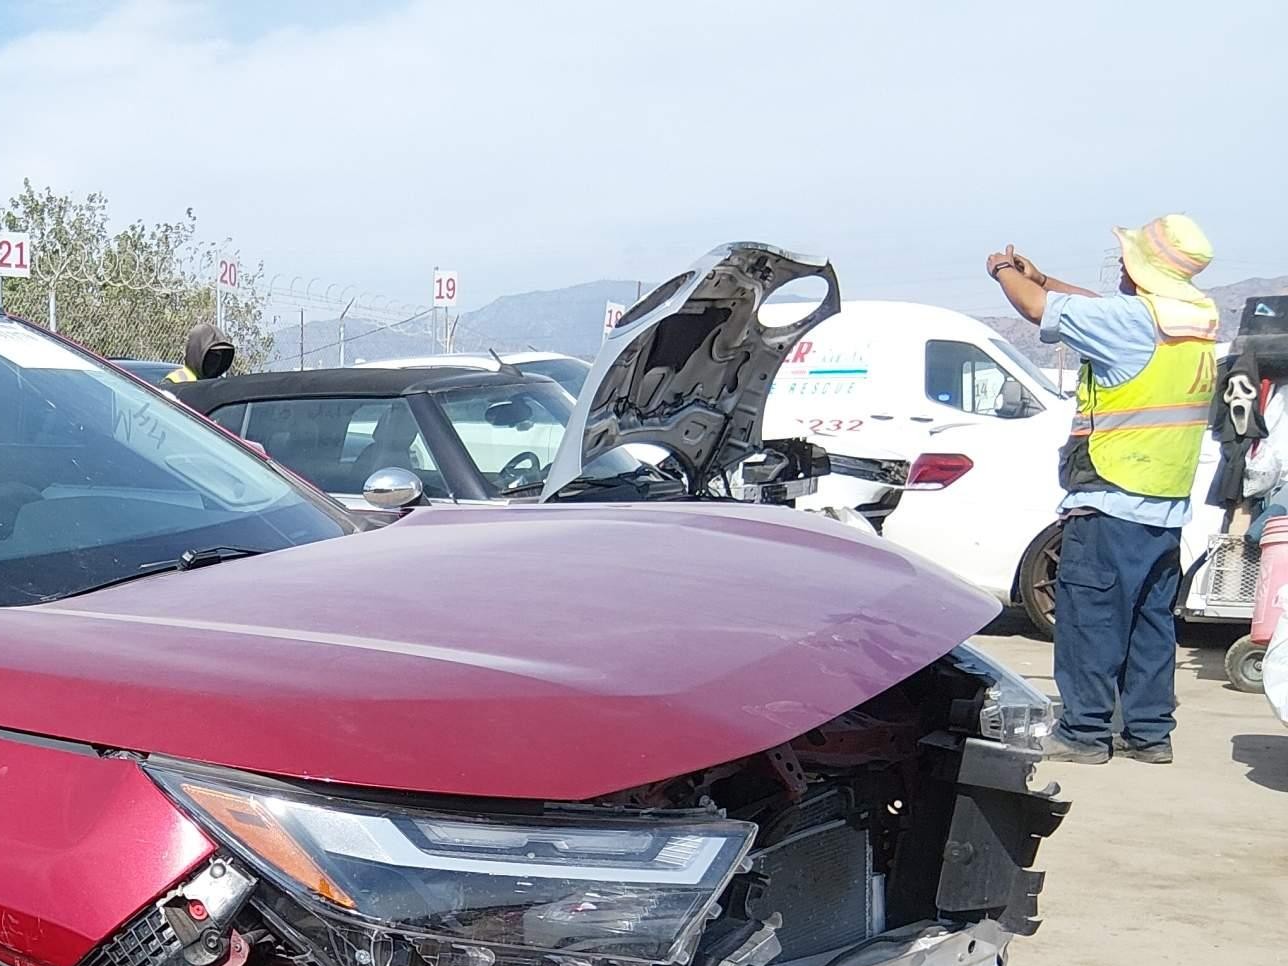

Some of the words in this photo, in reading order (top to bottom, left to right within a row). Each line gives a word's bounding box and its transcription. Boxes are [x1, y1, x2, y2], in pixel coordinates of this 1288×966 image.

[219, 260, 237, 287] 20
[435, 277, 456, 300] 19
[789, 382, 856, 395] RESCUE
[795, 418, 865, 433] 232
